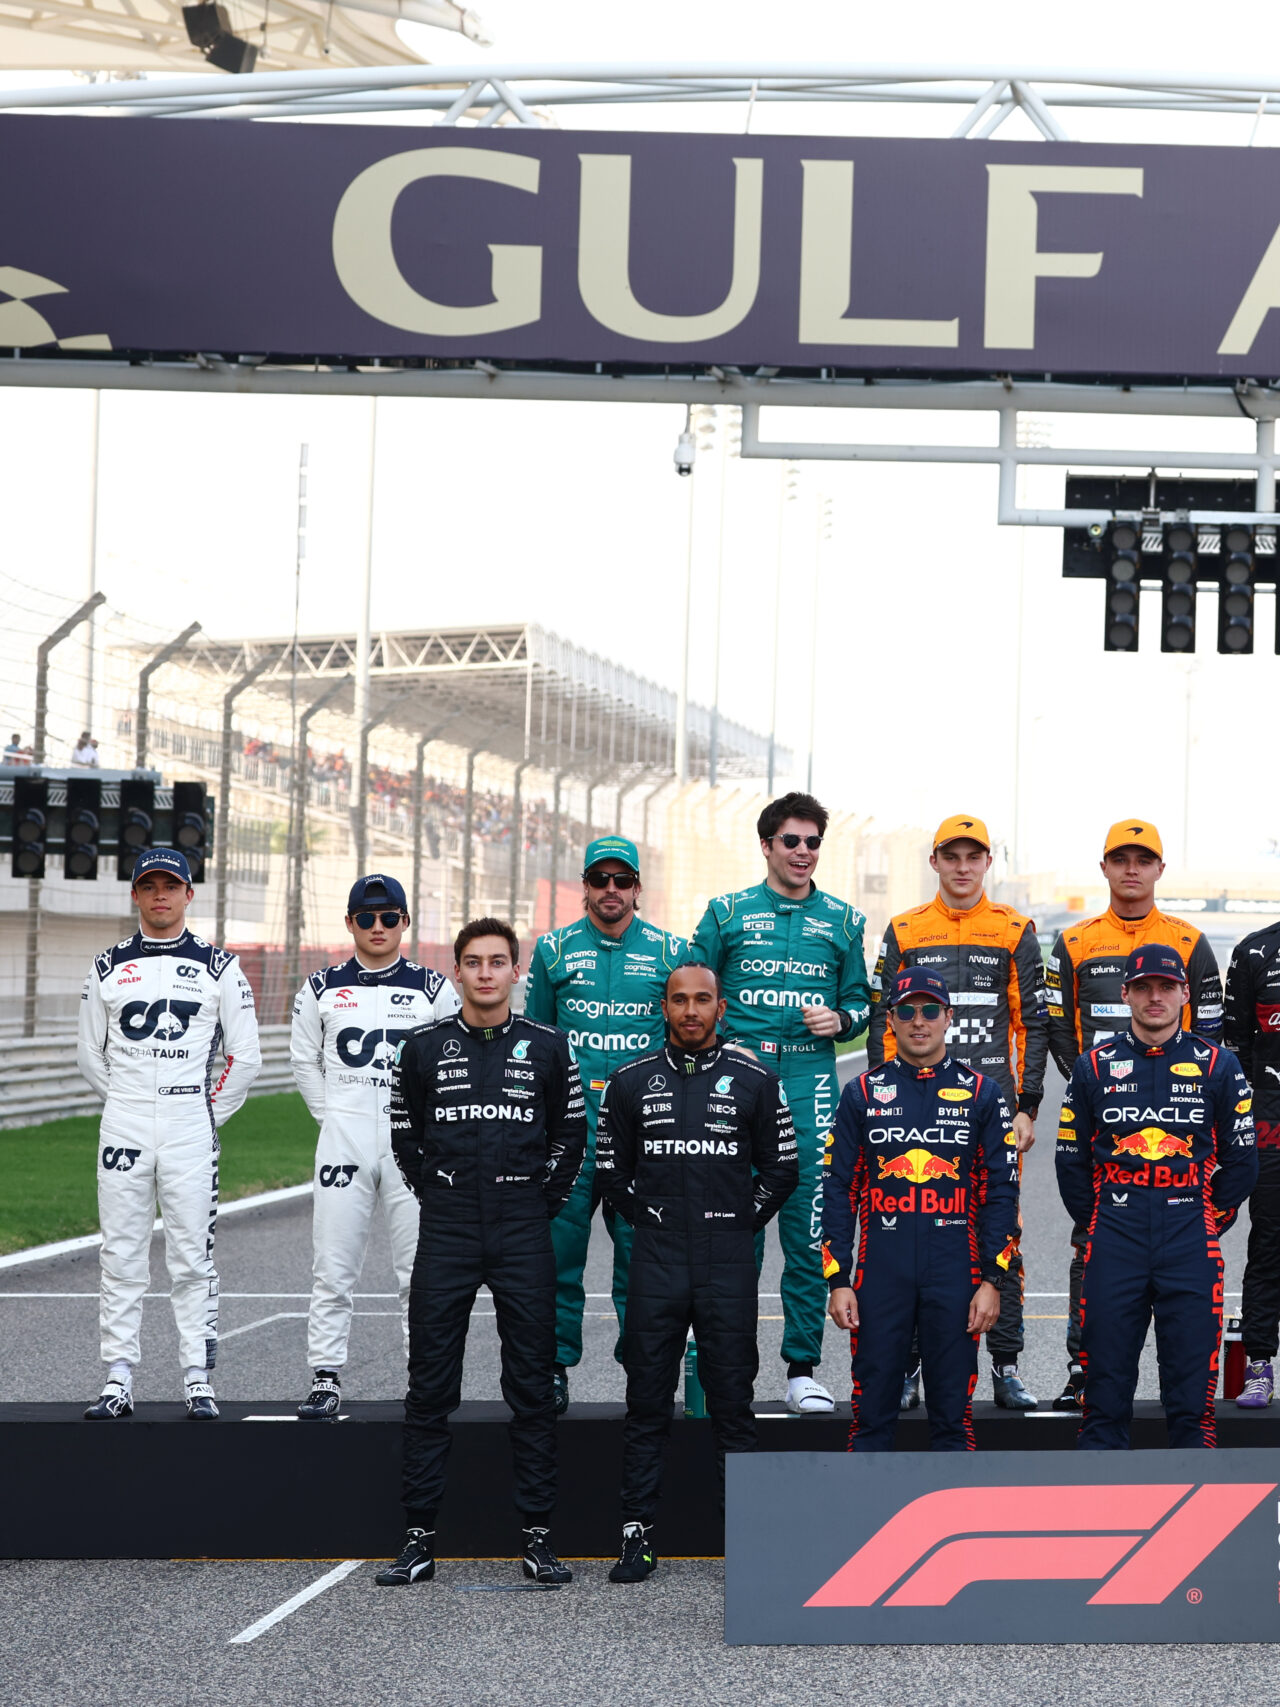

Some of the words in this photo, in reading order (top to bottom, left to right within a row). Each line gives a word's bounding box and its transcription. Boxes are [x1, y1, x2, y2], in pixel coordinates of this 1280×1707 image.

[333, 148, 1143, 348] GULF
[742, 912, 775, 921] aramco
[919, 933, 948, 942] android
[565, 950, 597, 960] aramco
[1090, 945, 1120, 953] android
[740, 957, 828, 977] cognizant
[1136, 956, 1144, 969] 1
[117, 976, 141, 985] ORLEN
[173, 984, 203, 993] HONDA
[739, 989, 824, 1008] aramco
[566, 999, 653, 1019] cognizant
[1093, 1005, 1115, 1014] DELL
[569, 1030, 650, 1050] aramco
[121, 1046, 189, 1059] ALPHATAURI
[782, 1044, 816, 1053] STROLL
[449, 1069, 468, 1078] UBS
[504, 1069, 535, 1081] INEOS
[338, 1073, 392, 1088] ALPHATAU
[1104, 1083, 1128, 1094] Mobil
[1169, 1096, 1205, 1104] HONDA
[435, 1104, 534, 1123] PETRONAS
[652, 1103, 672, 1112] UBS
[707, 1103, 736, 1115] INEOS
[867, 1107, 893, 1117] Mobil
[1102, 1107, 1205, 1124] ORACLE
[936, 1119, 970, 1127] HONDA
[869, 1128, 969, 1145] ORACLE
[644, 1140, 738, 1155] PETRONAS
[1104, 1163, 1150, 1186] Red
[1154, 1163, 1200, 1187] Bull
[870, 1186, 915, 1213] Red
[921, 1188, 966, 1214] Bull
